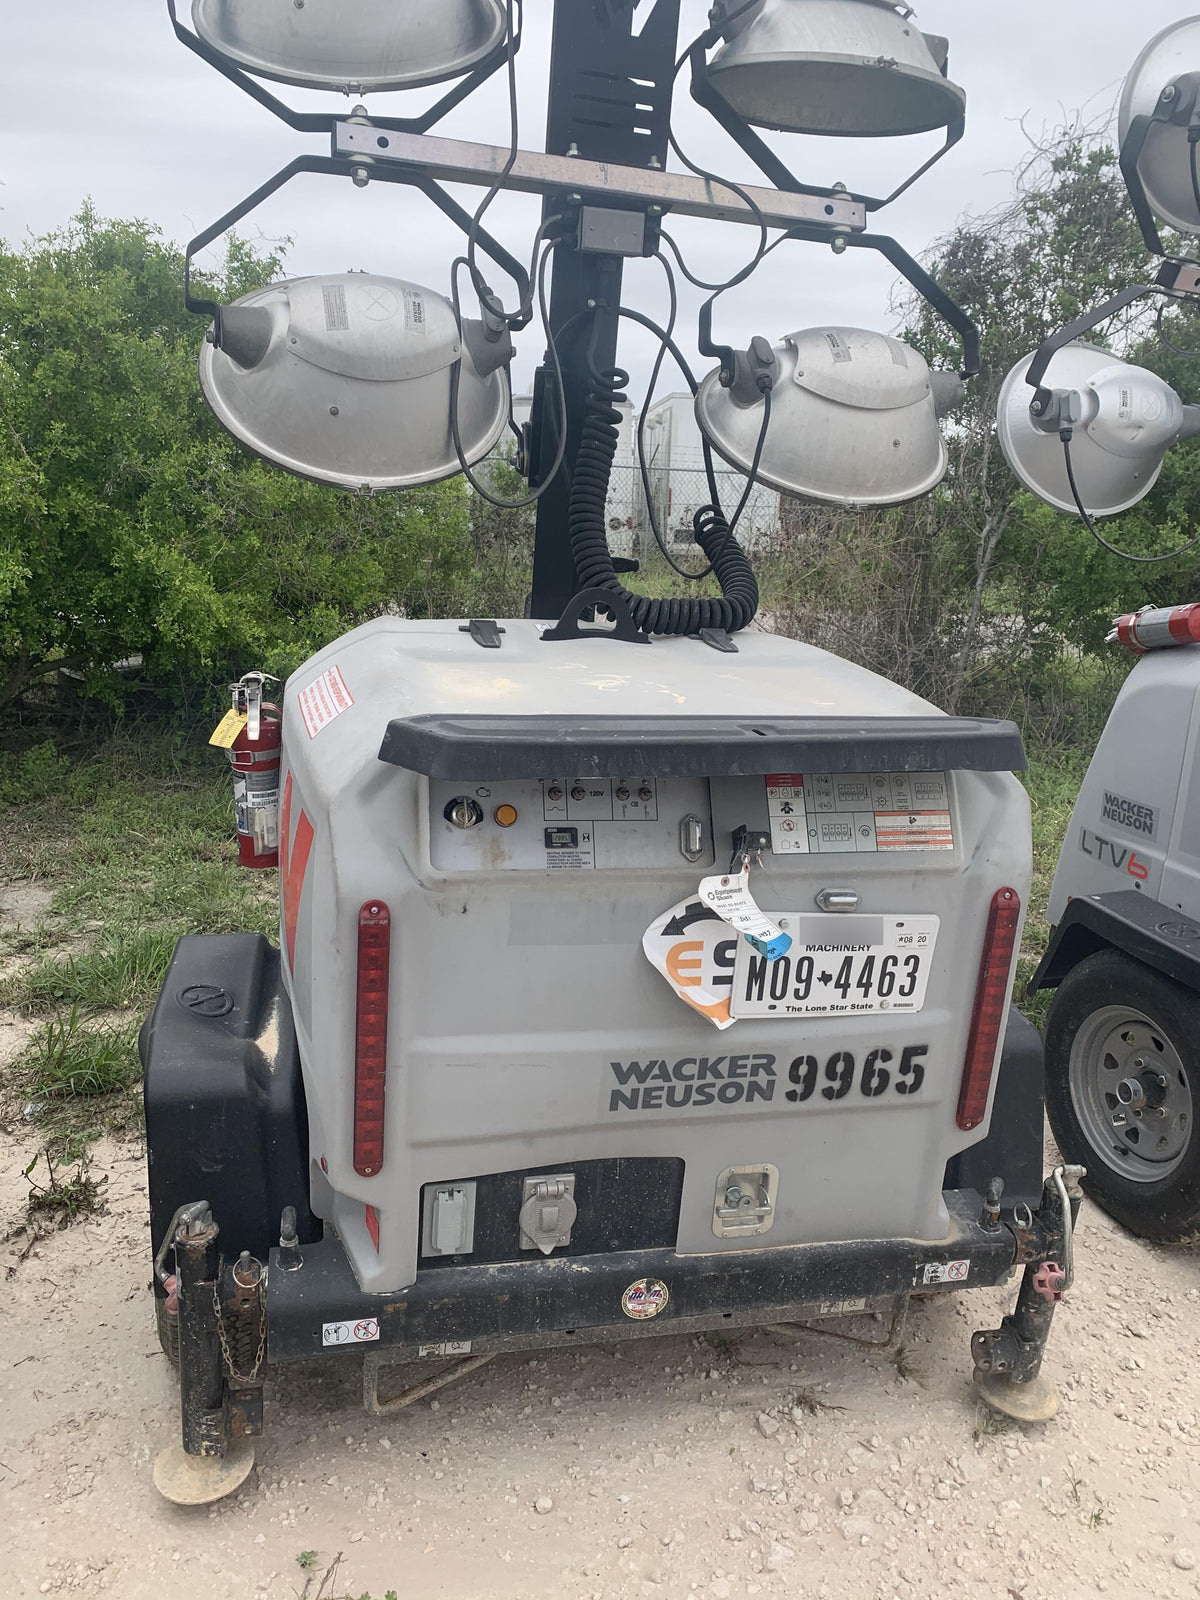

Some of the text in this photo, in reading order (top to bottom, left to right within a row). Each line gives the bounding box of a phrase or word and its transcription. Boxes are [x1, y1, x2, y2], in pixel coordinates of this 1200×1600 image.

[1103, 805, 1154, 834] NEUSON
[1104, 792, 1154, 821] WACKER
[1082, 830, 1148, 879] LTV6
[805, 944, 872, 952] MACHINERY
[805, 1004, 827, 1012] Lone
[829, 1003, 848, 1011] Star
[609, 1044, 929, 1103] WACKER 9965
[608, 1079, 777, 1112] NEUSON
